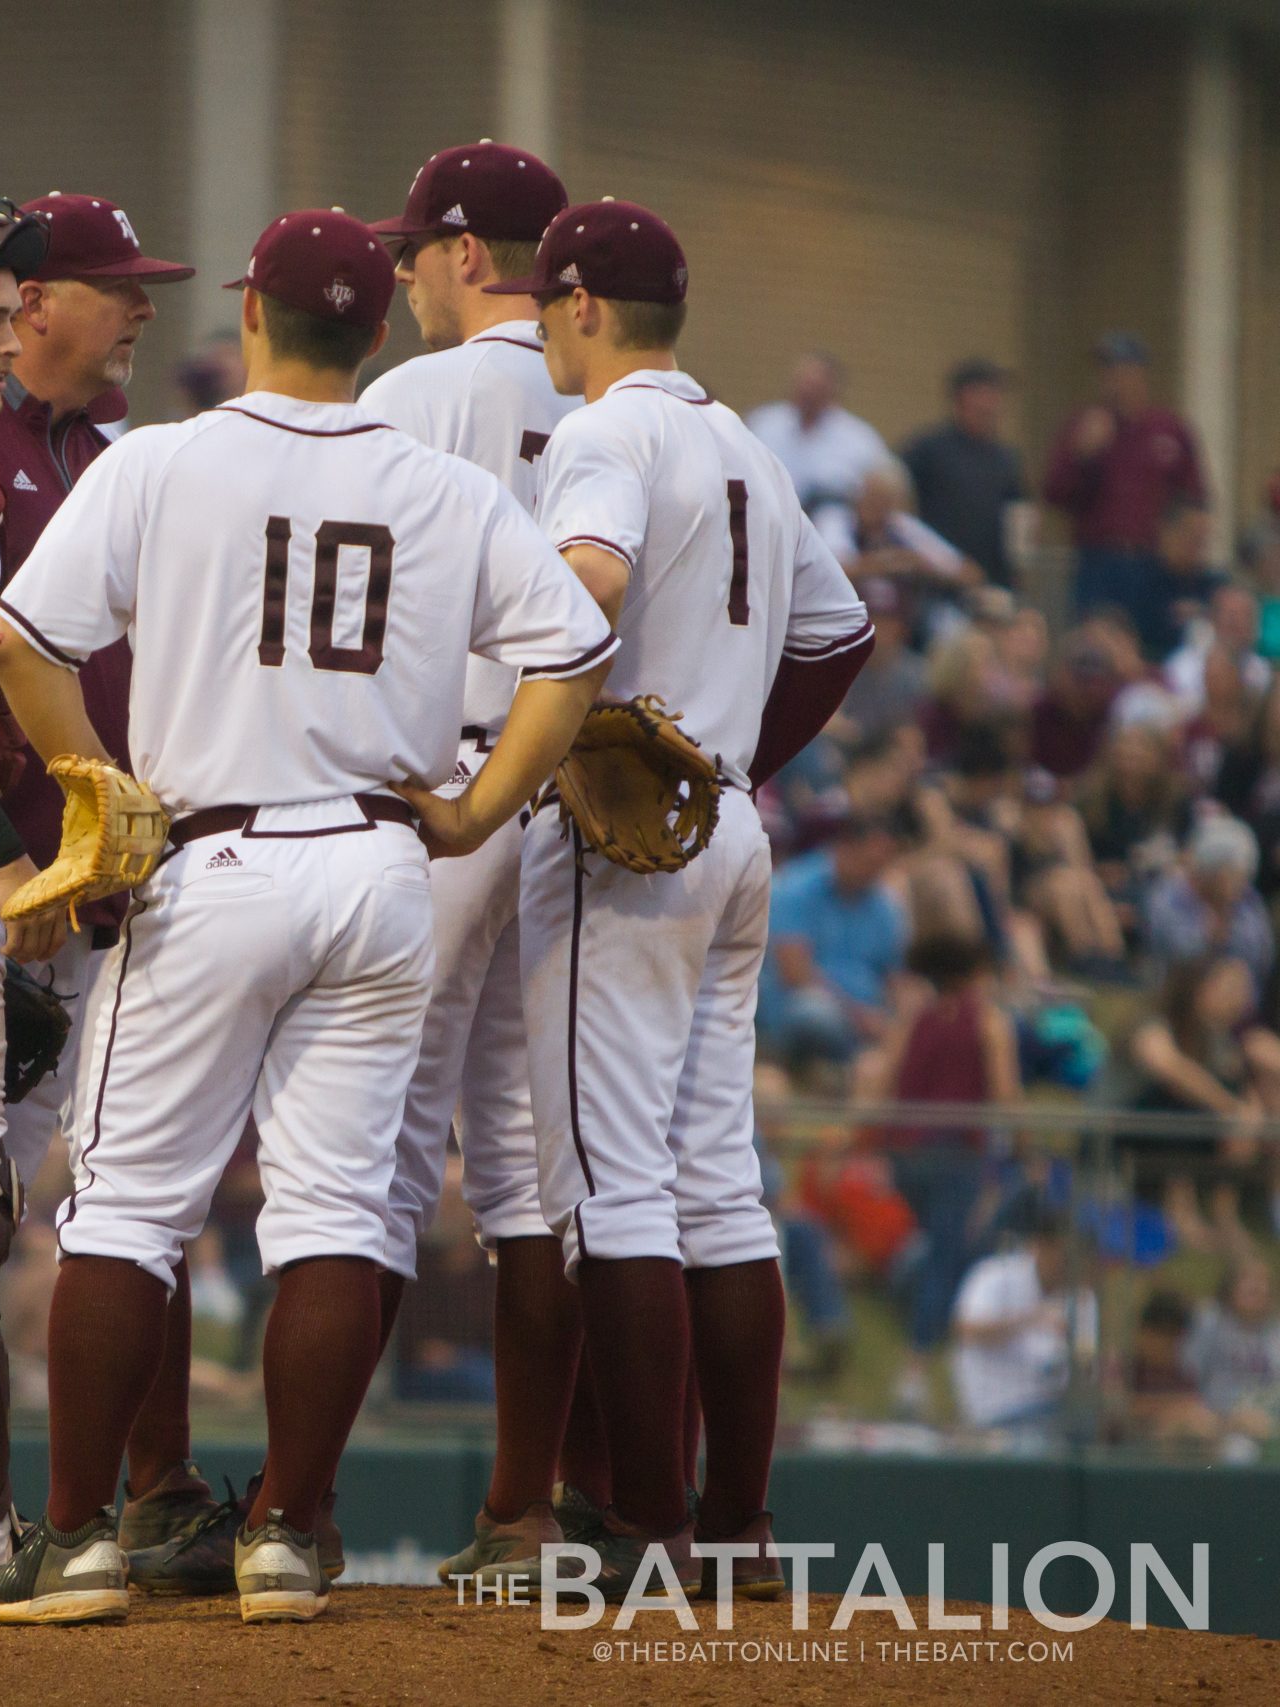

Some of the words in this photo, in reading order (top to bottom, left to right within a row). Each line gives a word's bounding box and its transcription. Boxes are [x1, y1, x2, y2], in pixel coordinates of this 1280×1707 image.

[258, 515, 397, 676] 10
[727, 479, 750, 626] 1
[205, 858, 243, 870] adidas
